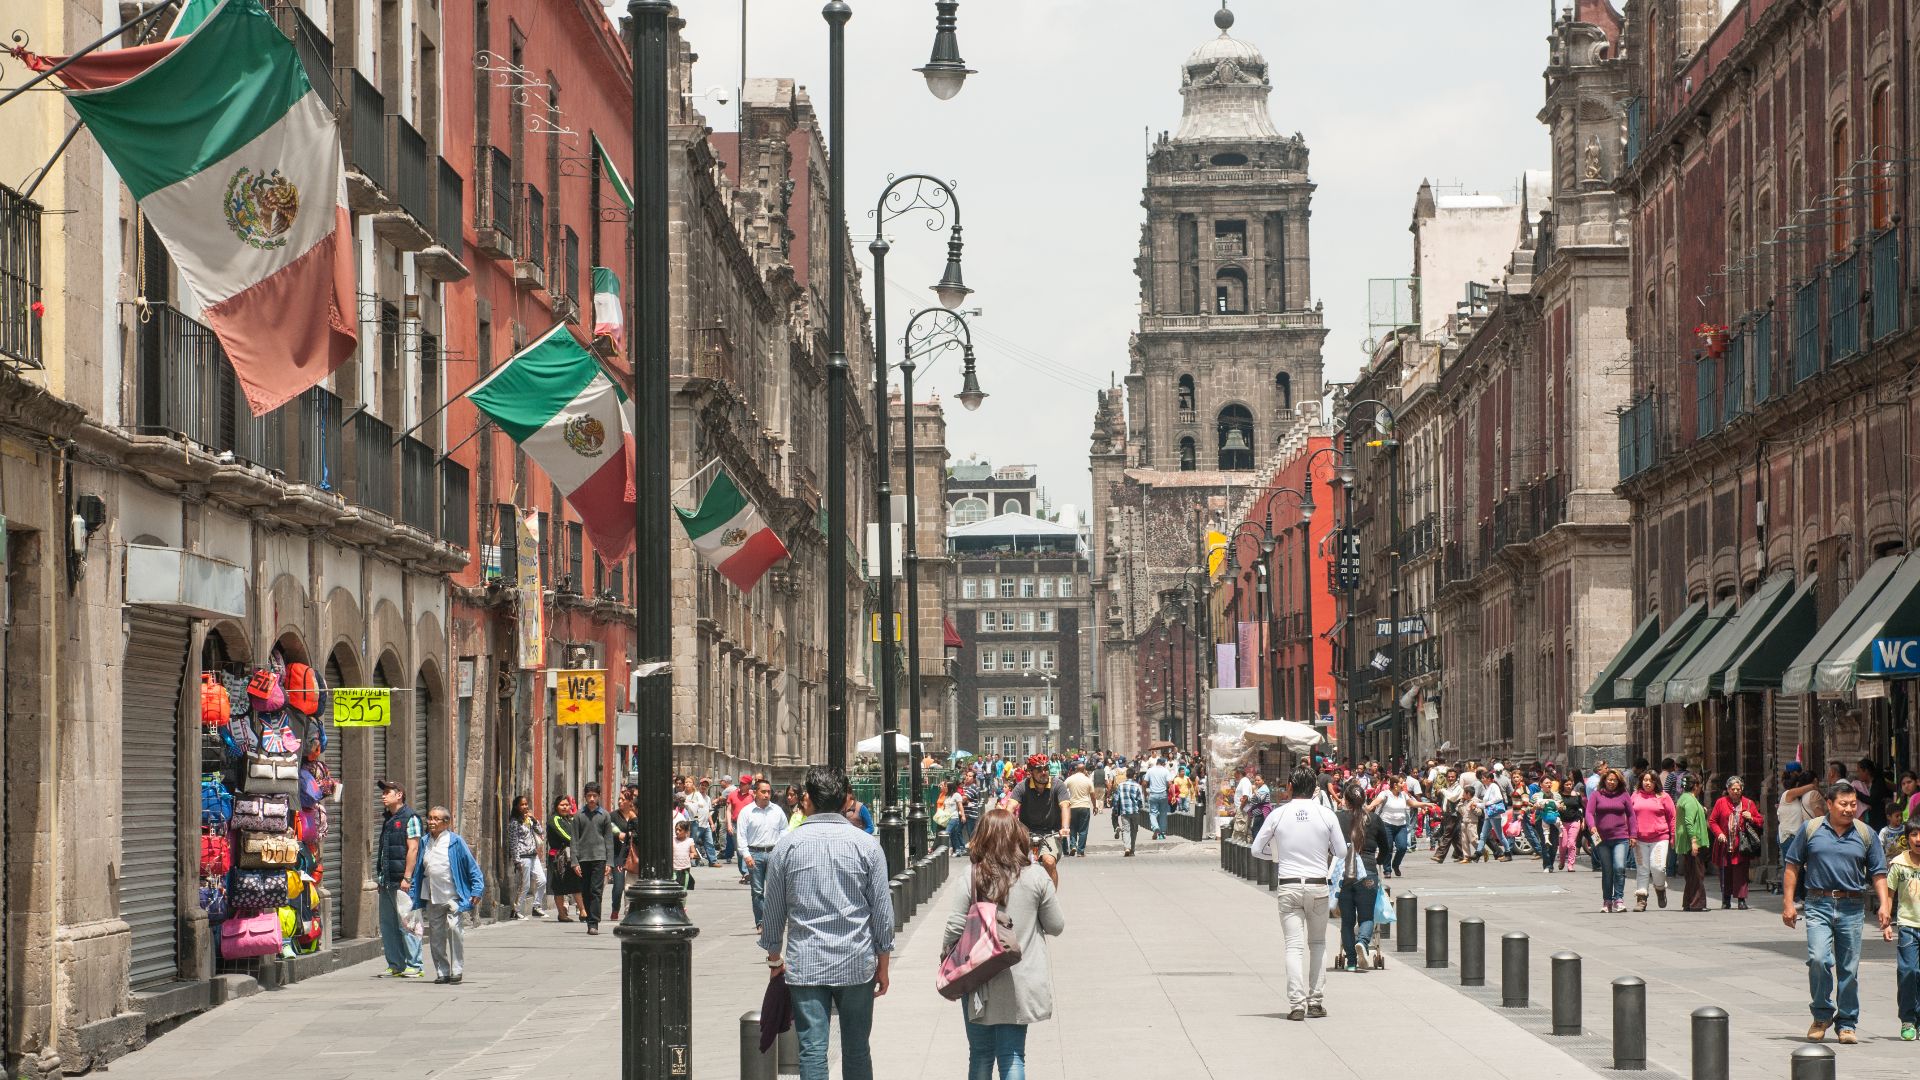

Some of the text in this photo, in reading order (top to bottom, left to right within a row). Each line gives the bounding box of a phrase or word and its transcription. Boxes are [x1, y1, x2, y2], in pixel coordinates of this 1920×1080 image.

[1878, 640, 1918, 669] WC
[567, 676, 596, 701] WC
[334, 696, 383, 723] $35
[262, 841, 297, 863] $50
